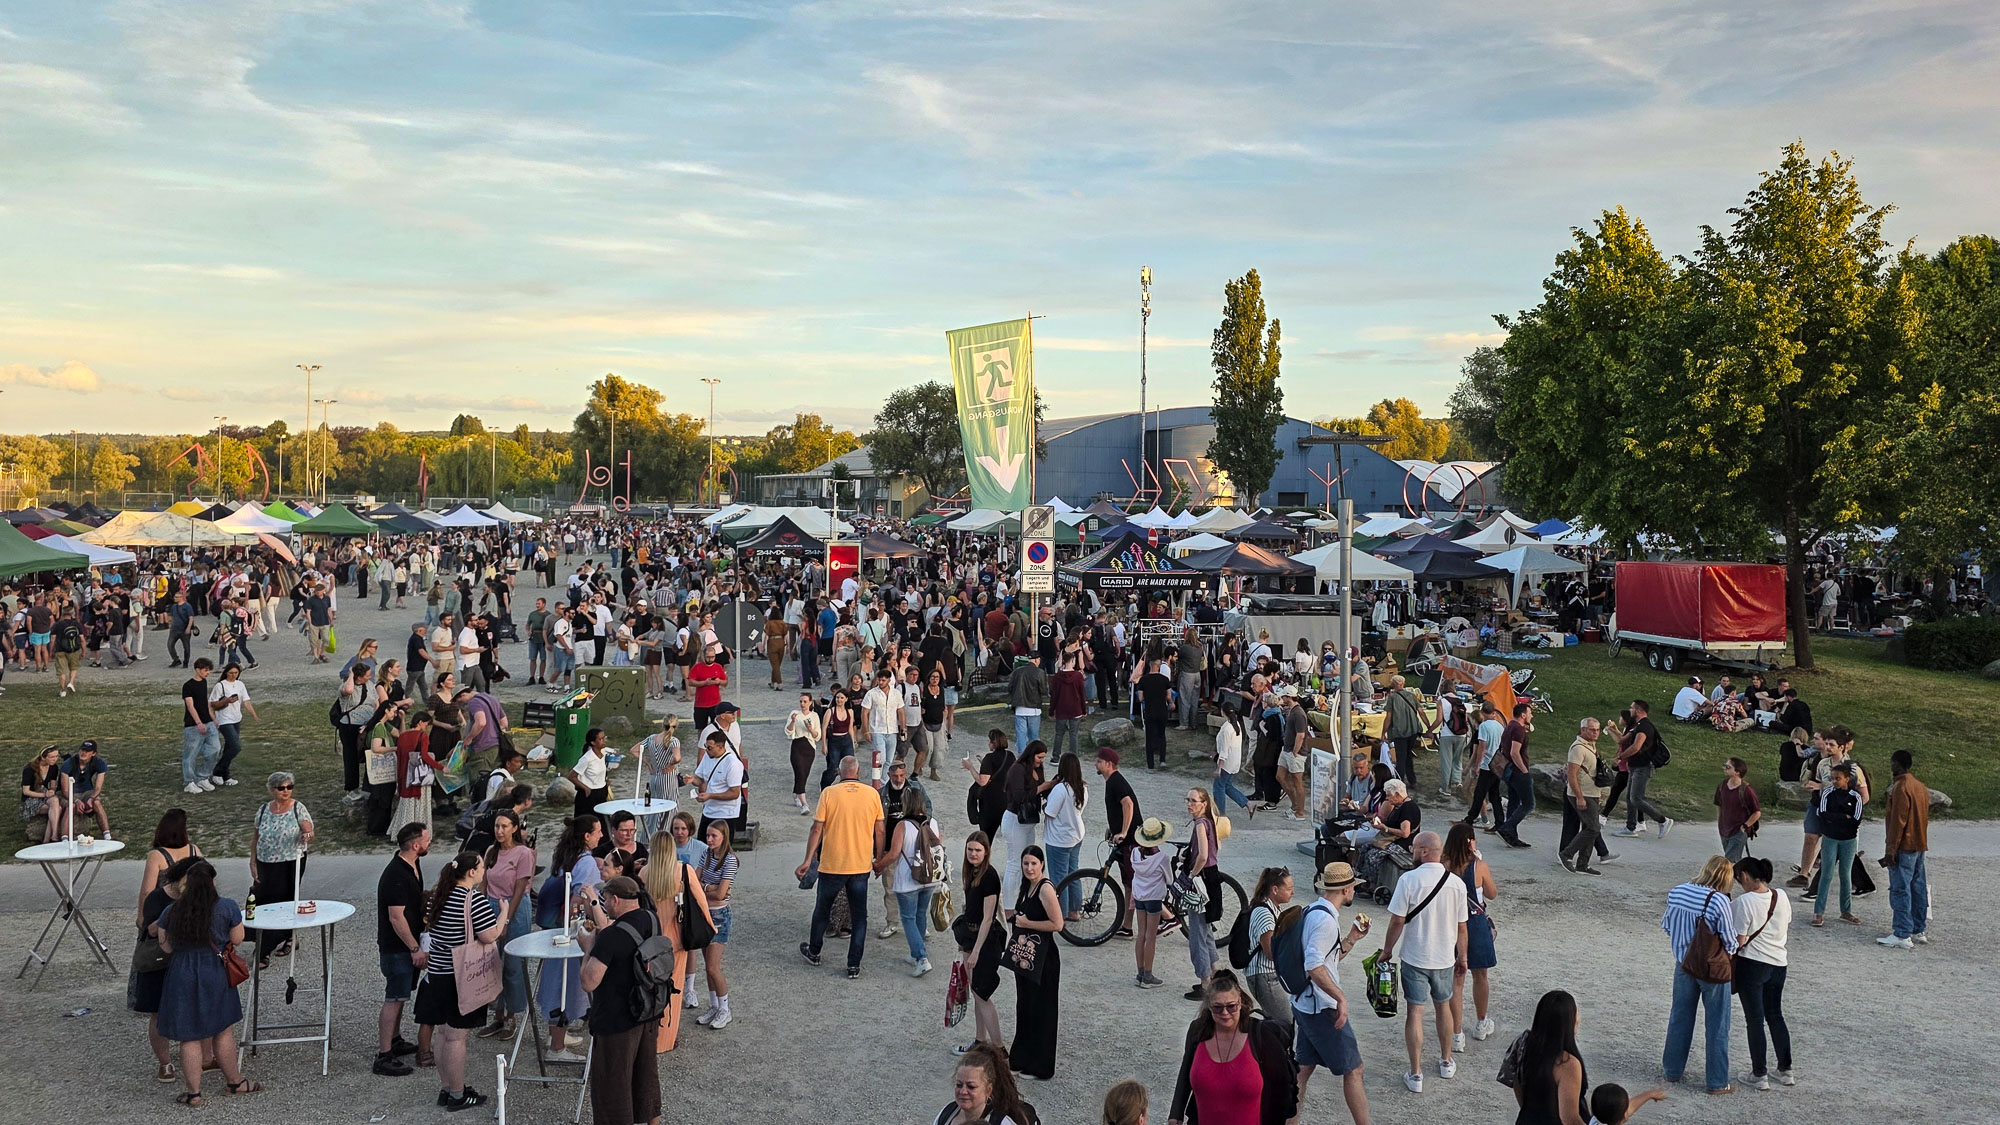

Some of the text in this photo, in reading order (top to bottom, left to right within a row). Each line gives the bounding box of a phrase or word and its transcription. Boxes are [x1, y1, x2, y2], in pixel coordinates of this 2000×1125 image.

[1136, 578, 1148, 586] ARE
[1149, 578, 1166, 586] MADE
[1166, 578, 1179, 586] FOR
